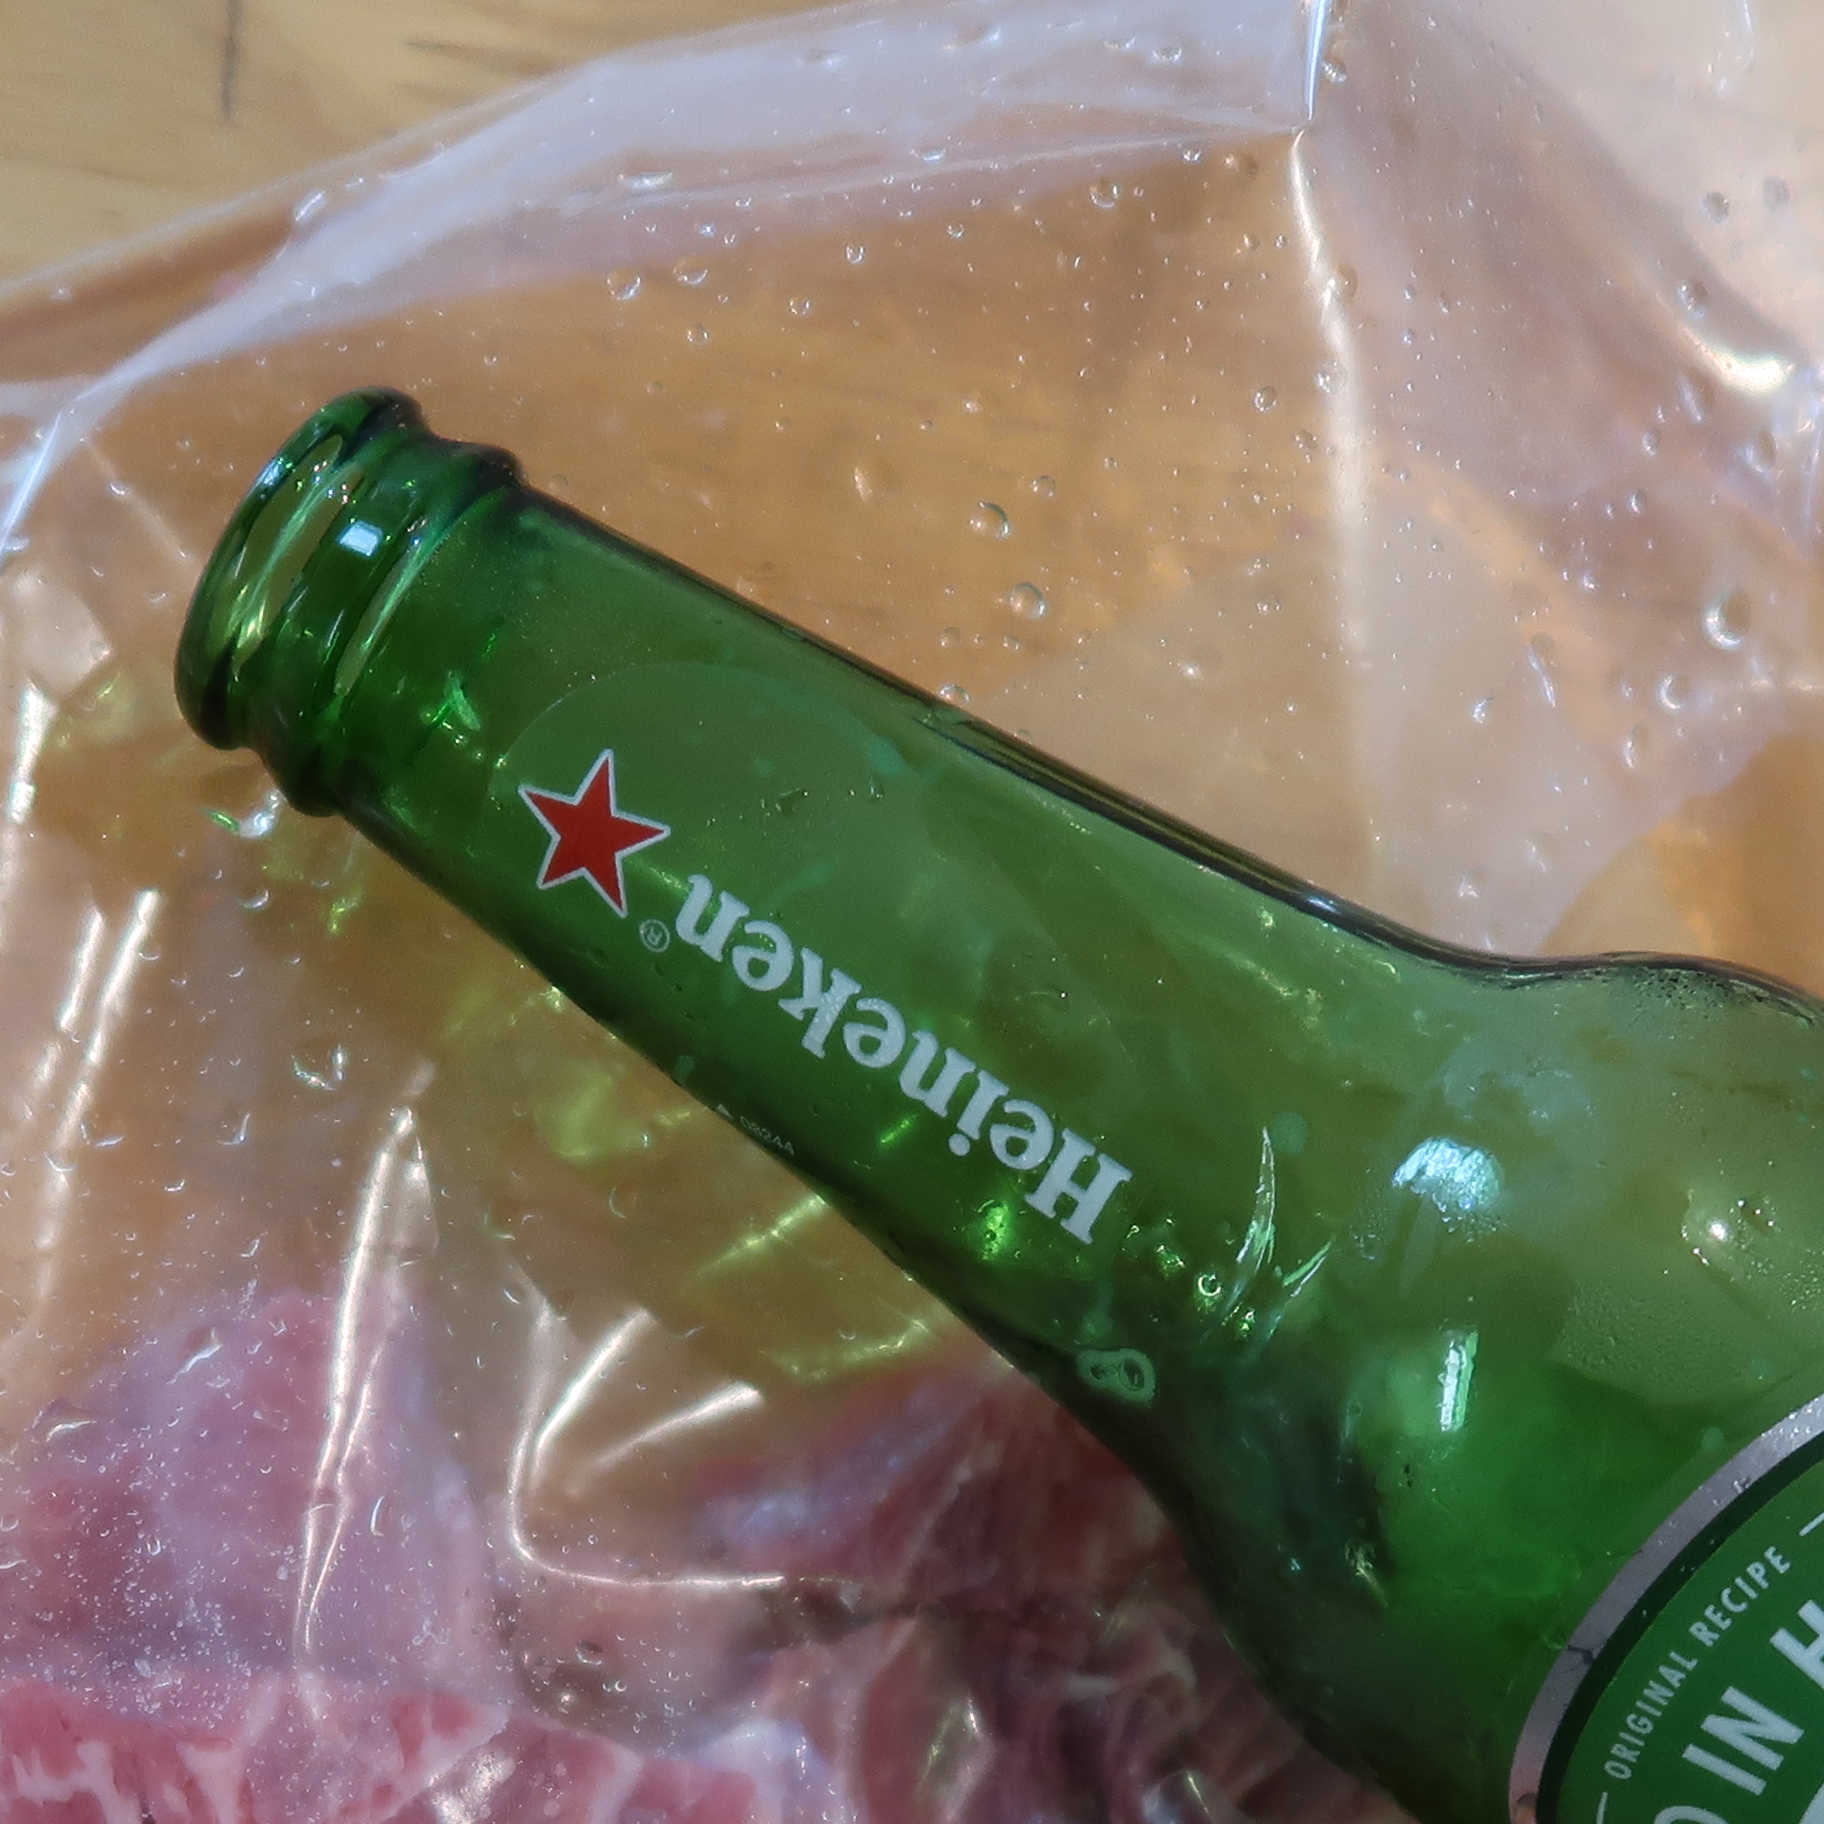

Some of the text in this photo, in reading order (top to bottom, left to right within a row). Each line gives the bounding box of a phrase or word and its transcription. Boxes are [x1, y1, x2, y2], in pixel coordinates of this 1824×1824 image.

[676, 874, 1133, 1245] Heineken
[1604, 1546, 1792, 1780] ORIGINAL RECIPE
[1682, 1686, 1805, 1796] IN
